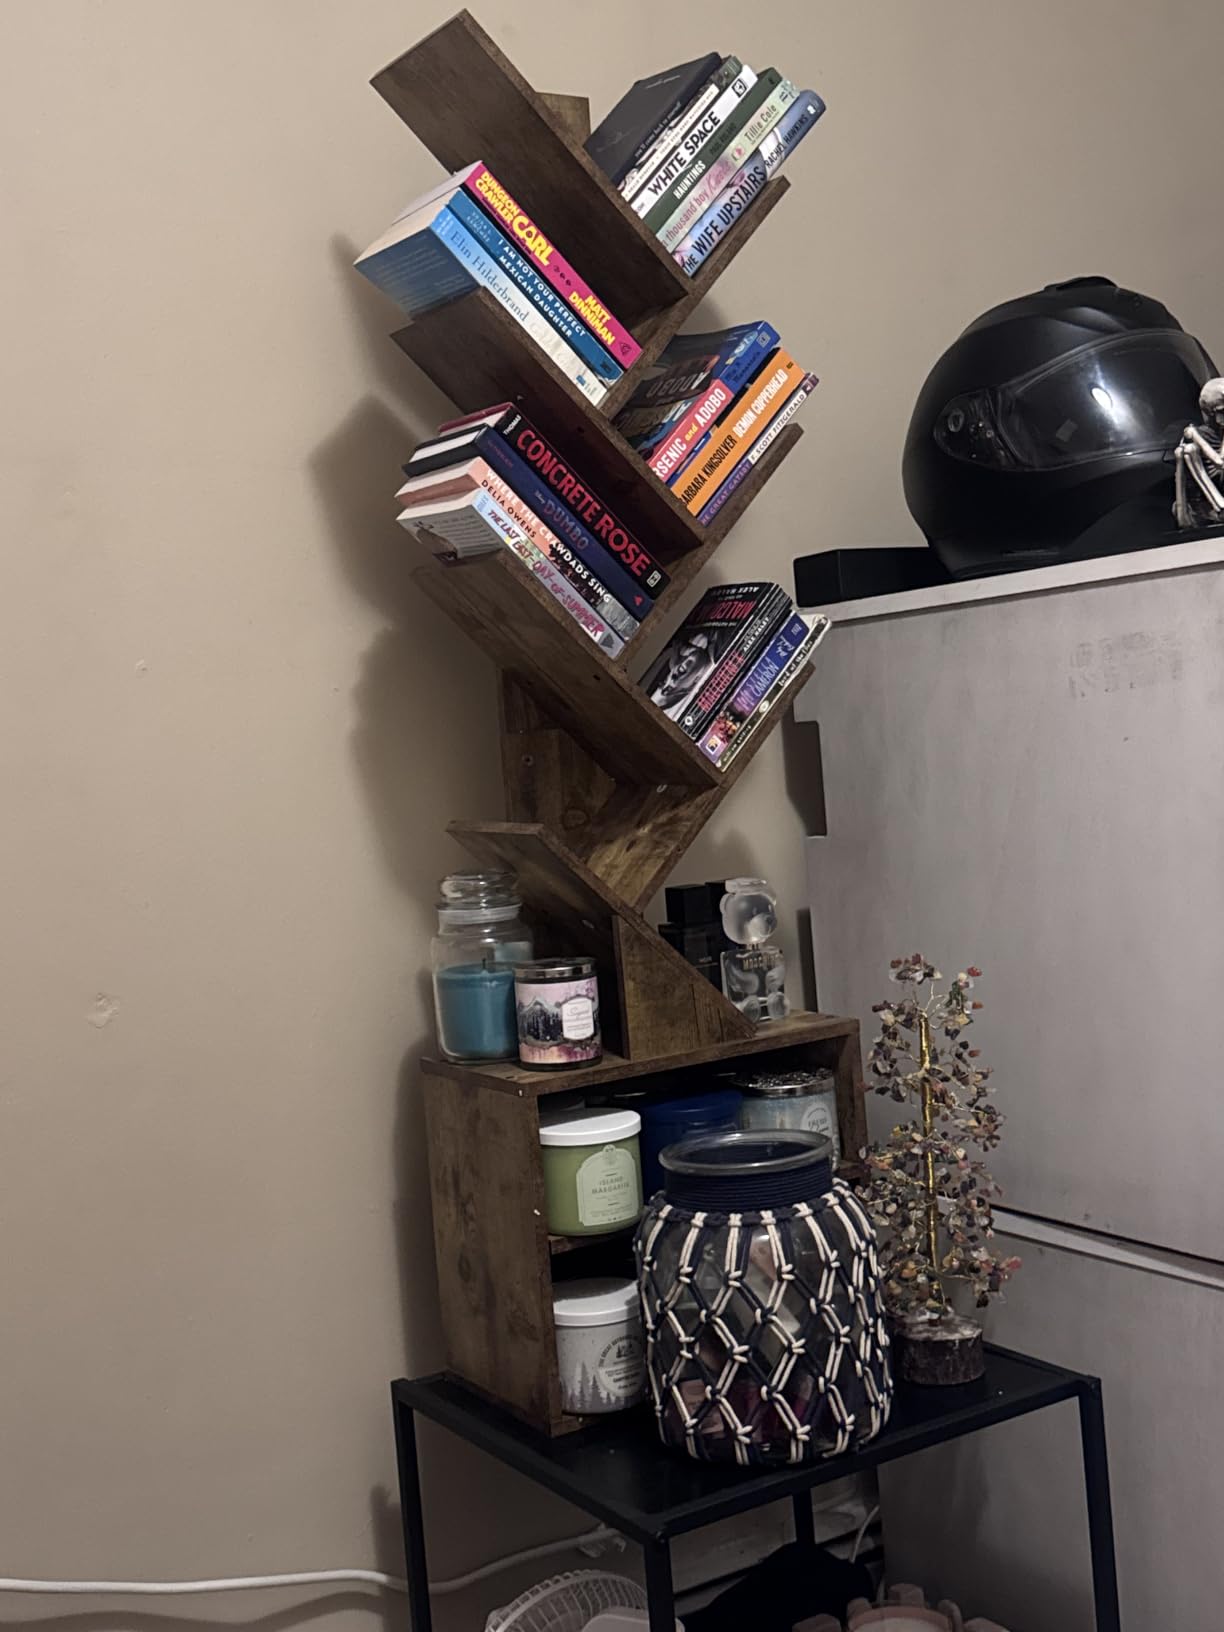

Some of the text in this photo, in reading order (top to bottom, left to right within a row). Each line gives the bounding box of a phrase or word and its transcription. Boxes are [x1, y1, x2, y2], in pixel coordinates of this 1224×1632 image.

[744, 120, 764, 141] Tillie
[759, 104, 776, 122] Cole
[763, 142, 787, 167] RACHEL
[783, 113, 808, 143] HAWKINS
[649, 111, 720, 195] WHITE SPACE
[673, 160, 704, 198] HAUNTINGS
[482, 172, 519, 216] DUNGEON
[664, 203, 696, 241] thousand
[691, 187, 711, 206] boy
[683, 256, 698, 273] THE
[693, 222, 721, 255] WIFE
[718, 167, 766, 223] UPSTAIRS
[473, 179, 514, 223] CRAWLER
[512, 215, 555, 266] CARL
[449, 231, 475, 259] Elin
[471, 257, 530, 321] Hilderbrand
[499, 256, 533, 293] MEXICAN
[533, 294, 572, 336] DAUGHTER
[502, 244, 516, 260] AM
[515, 260, 533, 278] NOT
[531, 278, 554, 302] YOUR
[553, 302, 585, 336] PERFECT
[567, 292, 615, 343] DINNIMAN
[585, 297, 610, 324] MATT
[732, 368, 789, 437] DEMON COPPERHEAD
[755, 432, 773, 453] SCOTT
[772, 393, 804, 432] FITZGERALD
[651, 437, 688, 479] RSENIC
[685, 424, 698, 441] and
[693, 388, 727, 426] ADOBO
[701, 434, 737, 476] KINGSOLVER
[481, 479, 505, 506] DELIA
[507, 506, 535, 538] OWENS
[516, 429, 600, 520] CONCRETE
[594, 514, 650, 575] ROSE
[707, 487, 731, 514] GREAT
[727, 461, 751, 490] GATSBY
[485, 469, 518, 505] WHERE
[518, 505, 540, 527] THE
[540, 528, 586, 578] CRAWDADS
[587, 579, 612, 603] SING
[487, 509, 504, 526] THE
[500, 521, 520, 542] LAST
[542, 499, 589, 550] DUMBO
[743, 617, 770, 651] ALEX HALEY
[753, 662, 779, 697] CAMERON
